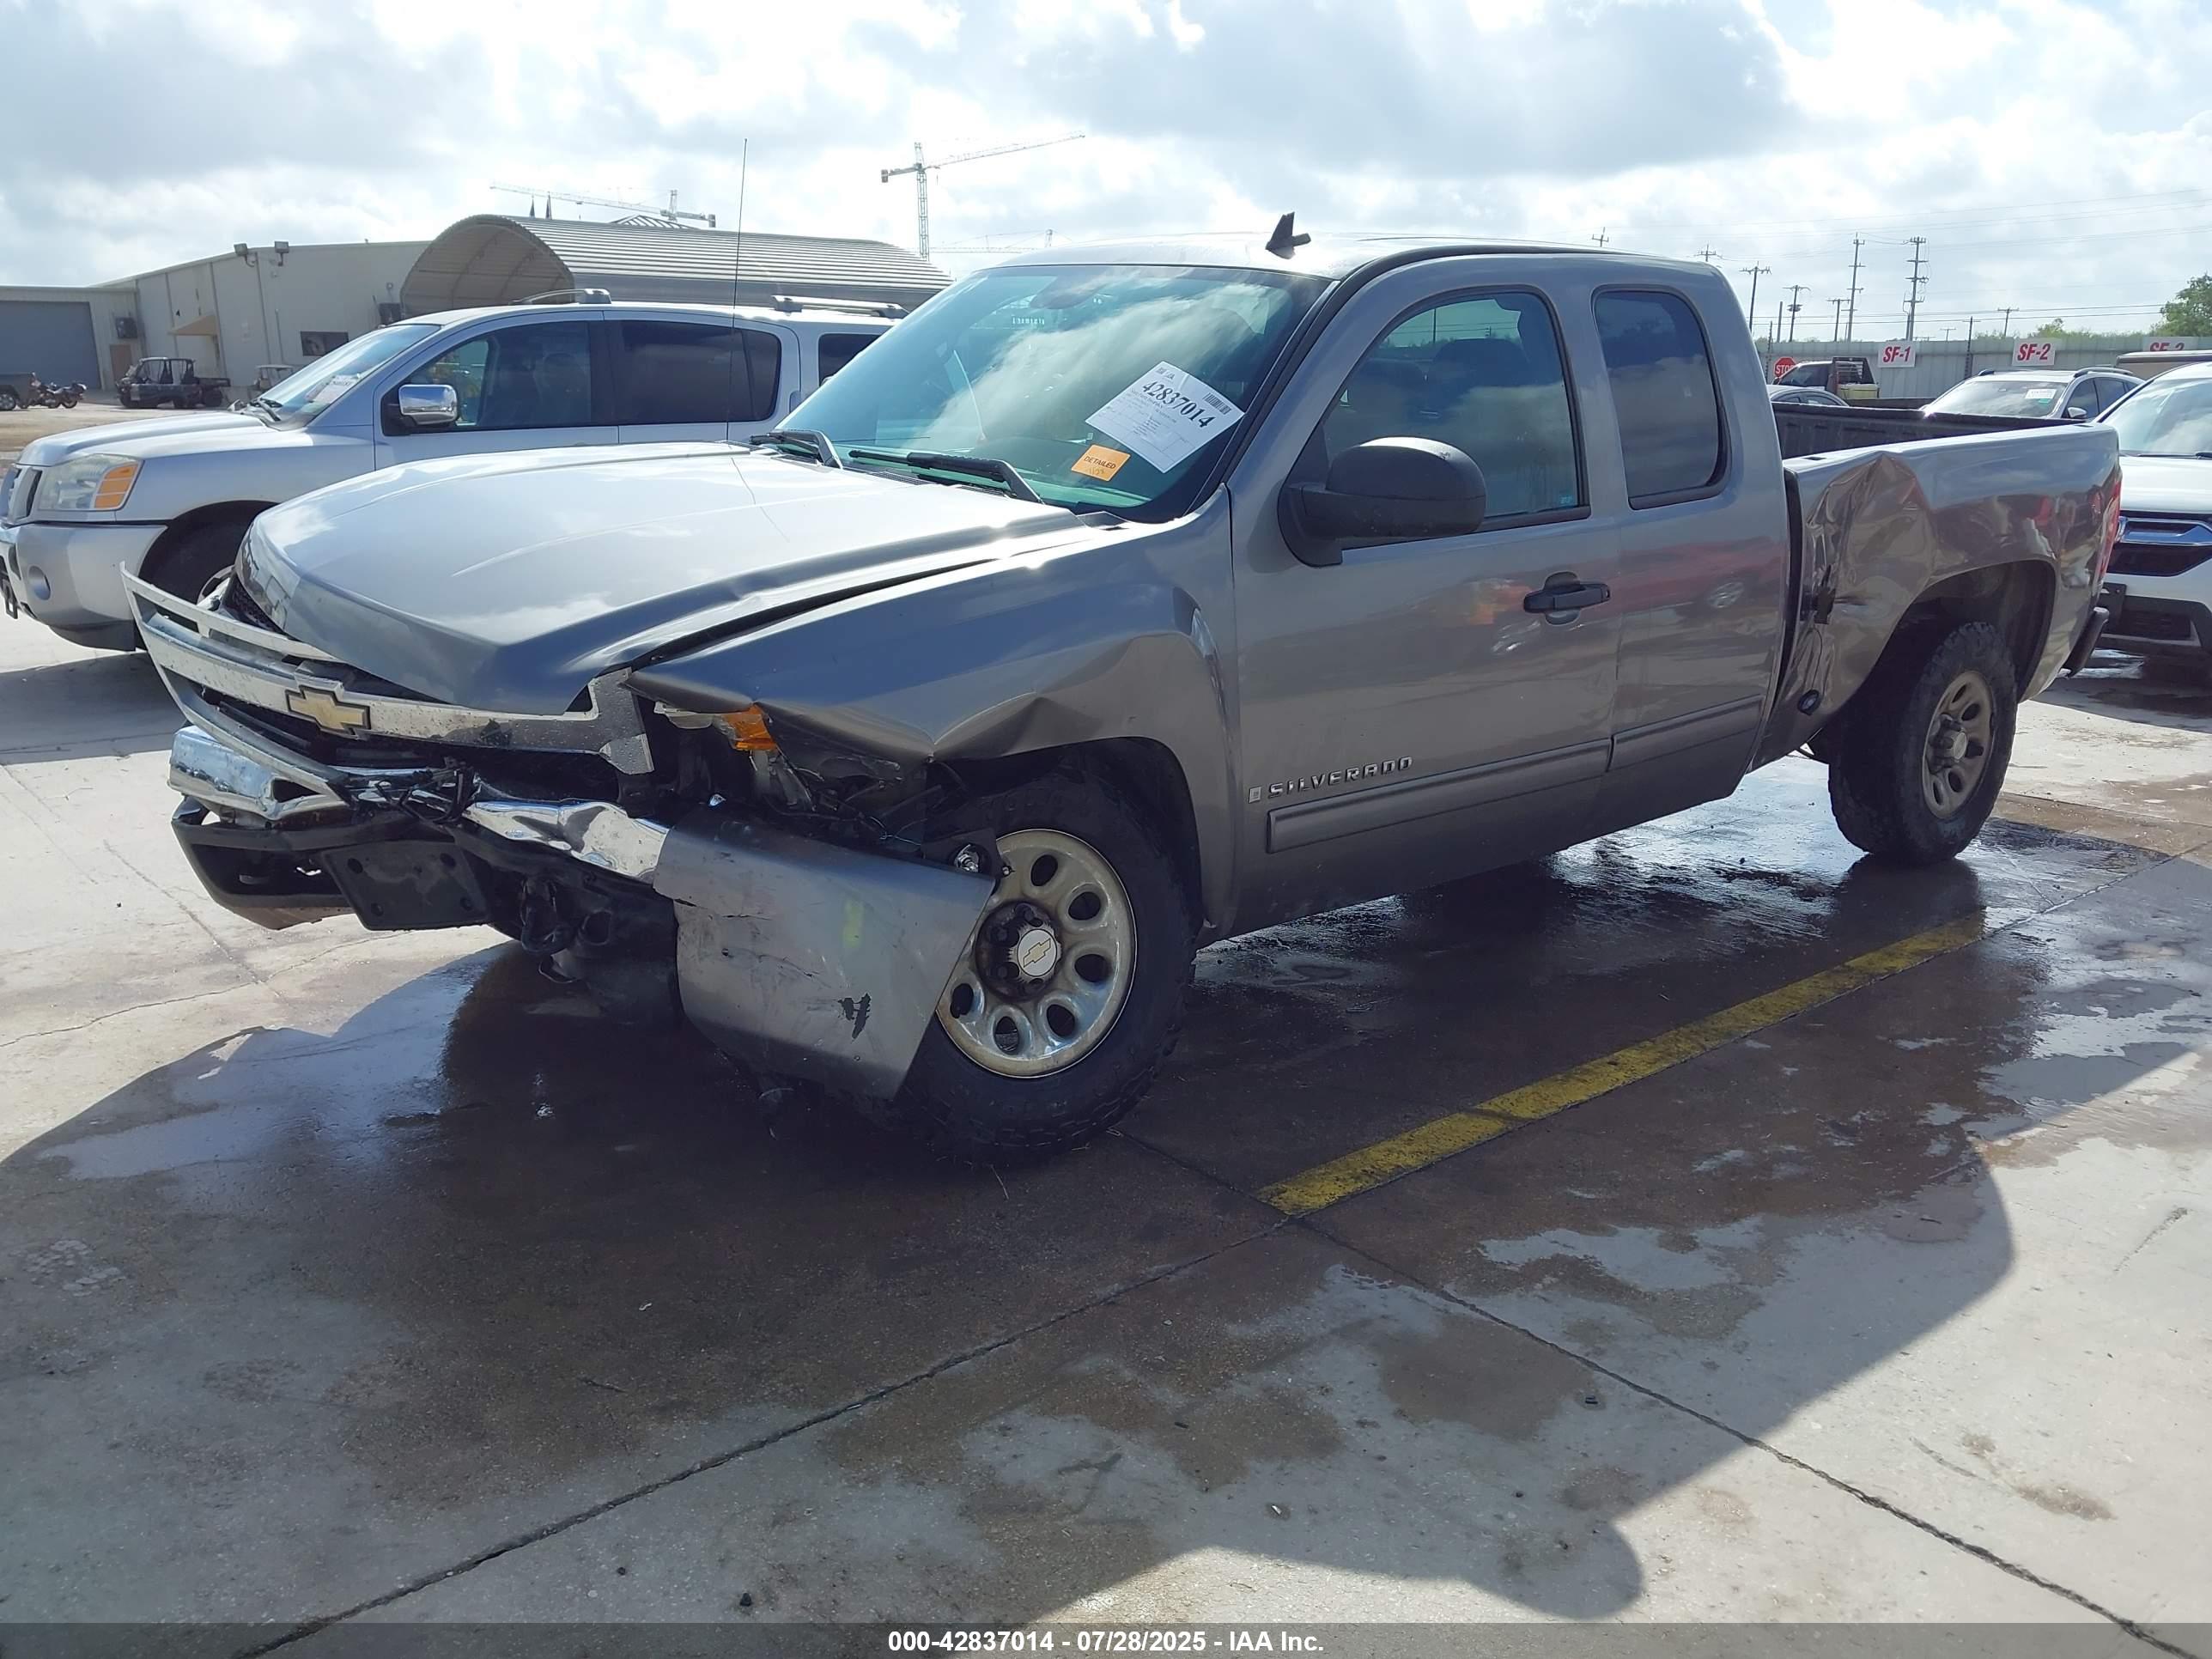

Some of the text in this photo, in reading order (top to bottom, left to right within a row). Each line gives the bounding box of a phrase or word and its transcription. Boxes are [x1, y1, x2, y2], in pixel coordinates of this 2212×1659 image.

[1882, 346, 1911, 363] SF-1
[2017, 343, 2051, 362] SF-2
[1141, 380, 1216, 428] 42837014
[1084, 456, 1116, 469] DETAILED
[1268, 757, 1413, 798] SILVERADO
